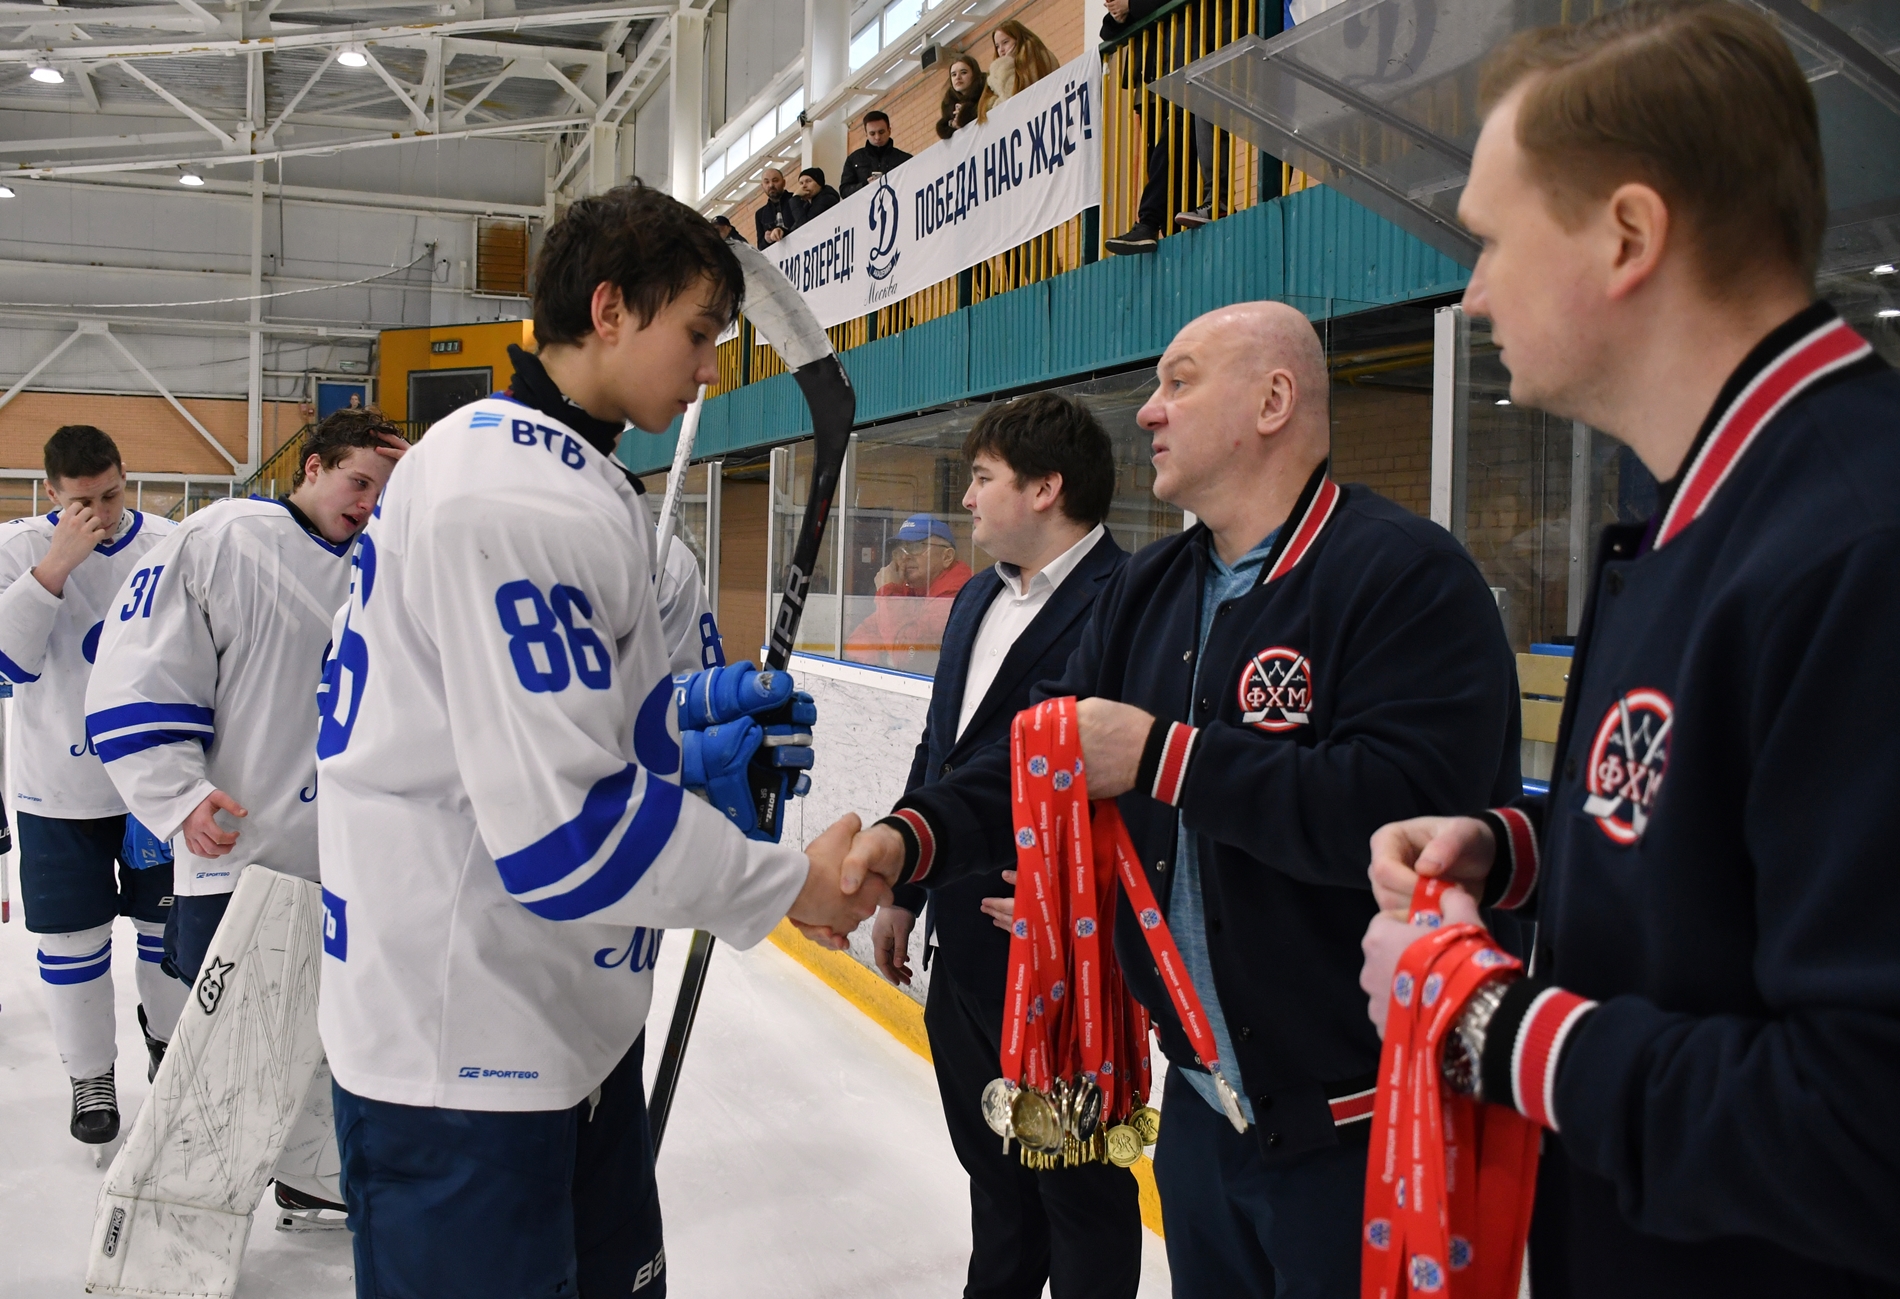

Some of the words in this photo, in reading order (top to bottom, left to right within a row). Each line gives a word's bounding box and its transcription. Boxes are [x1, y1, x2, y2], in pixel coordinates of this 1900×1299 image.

[915, 155, 979, 241] ПОБЕДА
[984, 127, 1023, 202] НАС
[803, 225, 854, 293] ВПЕРЁД!
[511, 418, 587, 471] ВТБ
[119, 564, 166, 622] 31
[497, 578, 612, 694] 86
[1245, 686, 1307, 708] ФХМ
[482, 1069, 539, 1080] SPORTEGO
